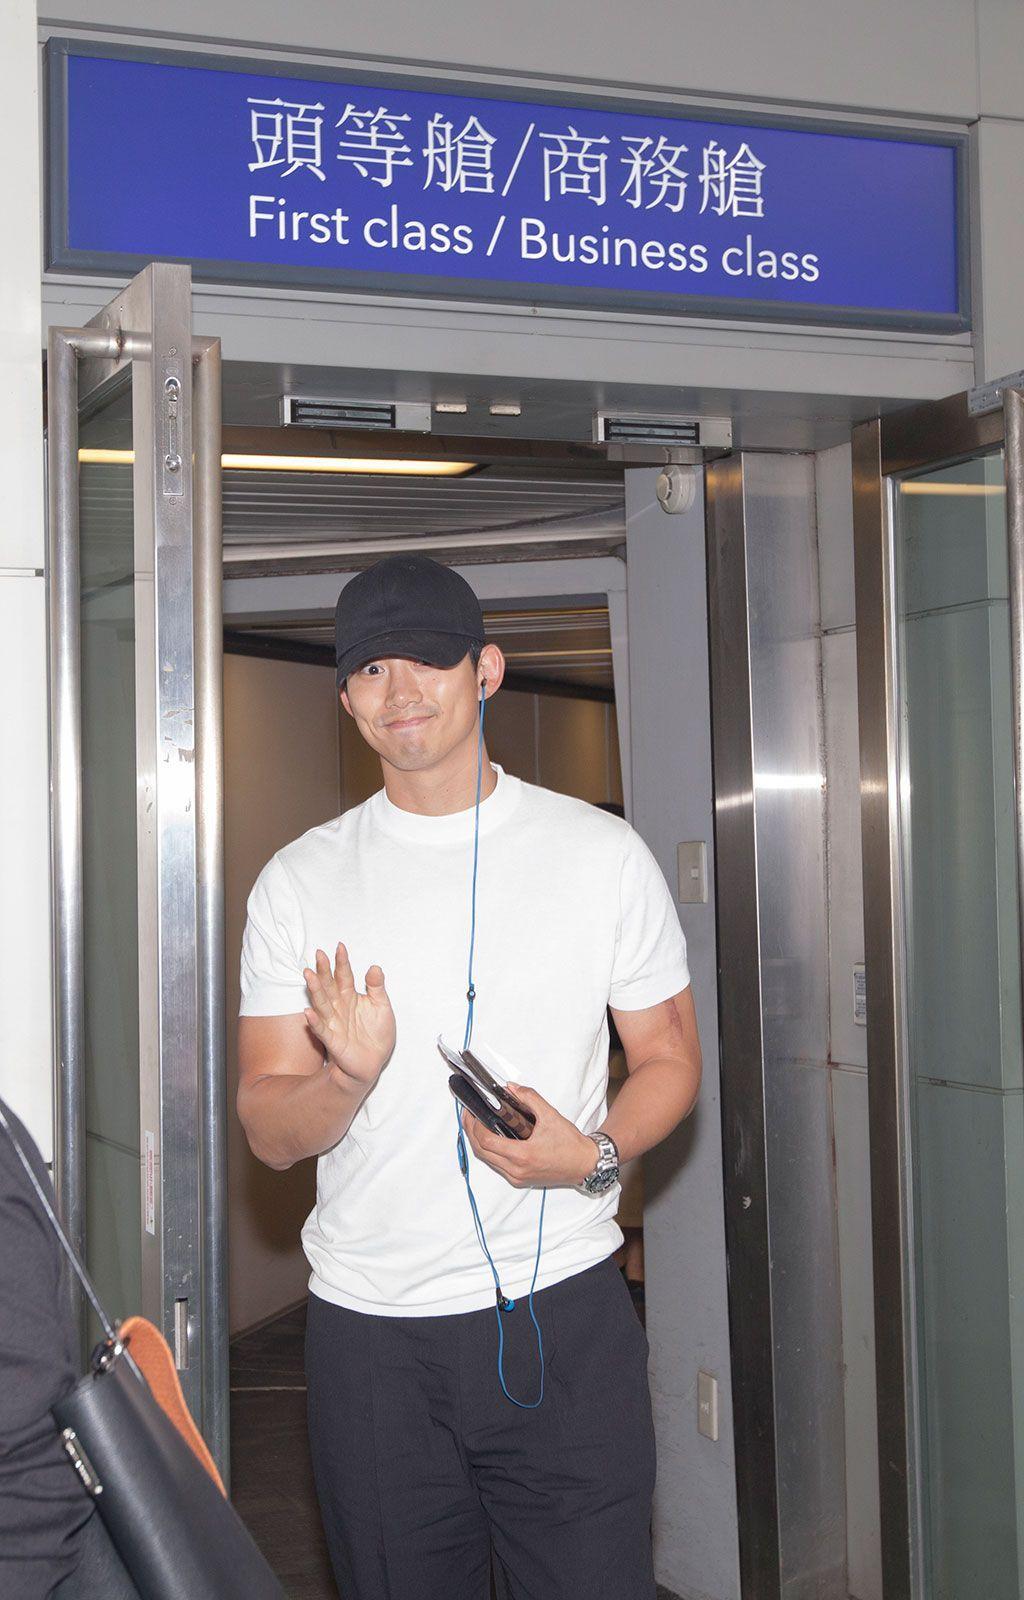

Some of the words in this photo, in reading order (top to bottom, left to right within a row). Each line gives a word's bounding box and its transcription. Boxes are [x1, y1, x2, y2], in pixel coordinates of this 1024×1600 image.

[246, 96, 768, 219] 頭等艙/商務艙
[248, 193, 350, 246] First
[363, 203, 474, 256] class
[485, 213, 506, 258] /
[520, 217, 709, 274] Business
[721, 233, 820, 283] class
